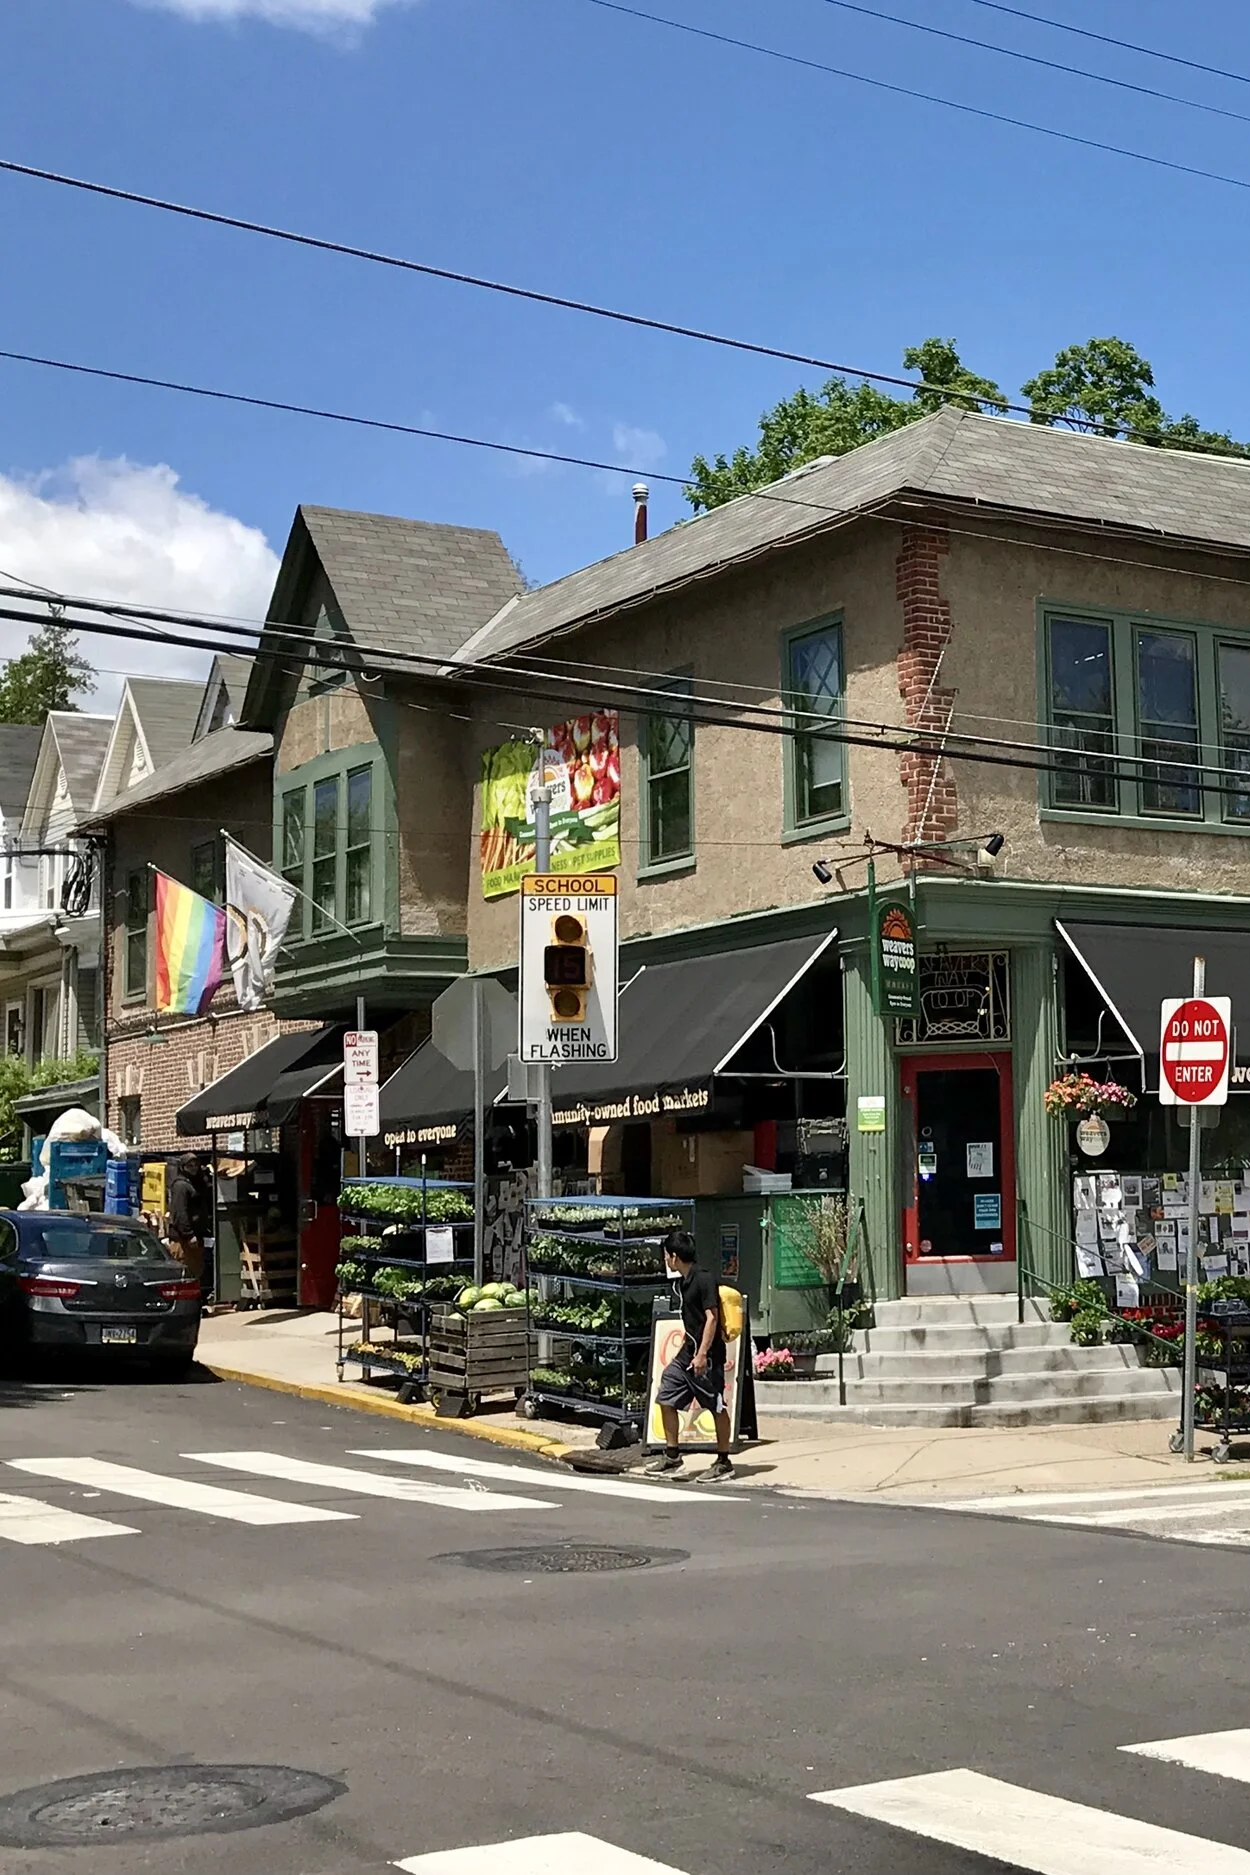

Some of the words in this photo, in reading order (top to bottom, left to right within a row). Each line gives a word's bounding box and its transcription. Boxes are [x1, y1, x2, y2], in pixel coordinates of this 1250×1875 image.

[486, 876, 502, 890] FOOD
[572, 855, 585, 867] PET
[585, 846, 616, 863] SUPPLIES
[534, 879, 605, 893] SCHOOL
[529, 898, 571, 911] SPEED
[578, 897, 610, 911] LIMIT
[882, 938, 914, 956] weavers
[547, 1028, 591, 1042] WHEN
[1172, 1020, 1189, 1037] DO
[1194, 1020, 1220, 1036] NOT
[346, 1034, 357, 1046] NO
[352, 1049, 370, 1057] ANY
[531, 1044, 607, 1058] FLASHING
[1174, 1066, 1213, 1083] ENTER
[551, 1096, 630, 1126] munity-owned
[633, 1092, 660, 1116] food
[662, 1087, 708, 1110] markets
[206, 1114, 236, 1130] weavers
[384, 1131, 405, 1150] open
[407, 1129, 416, 1143] to
[418, 1124, 457, 1145] everyone
